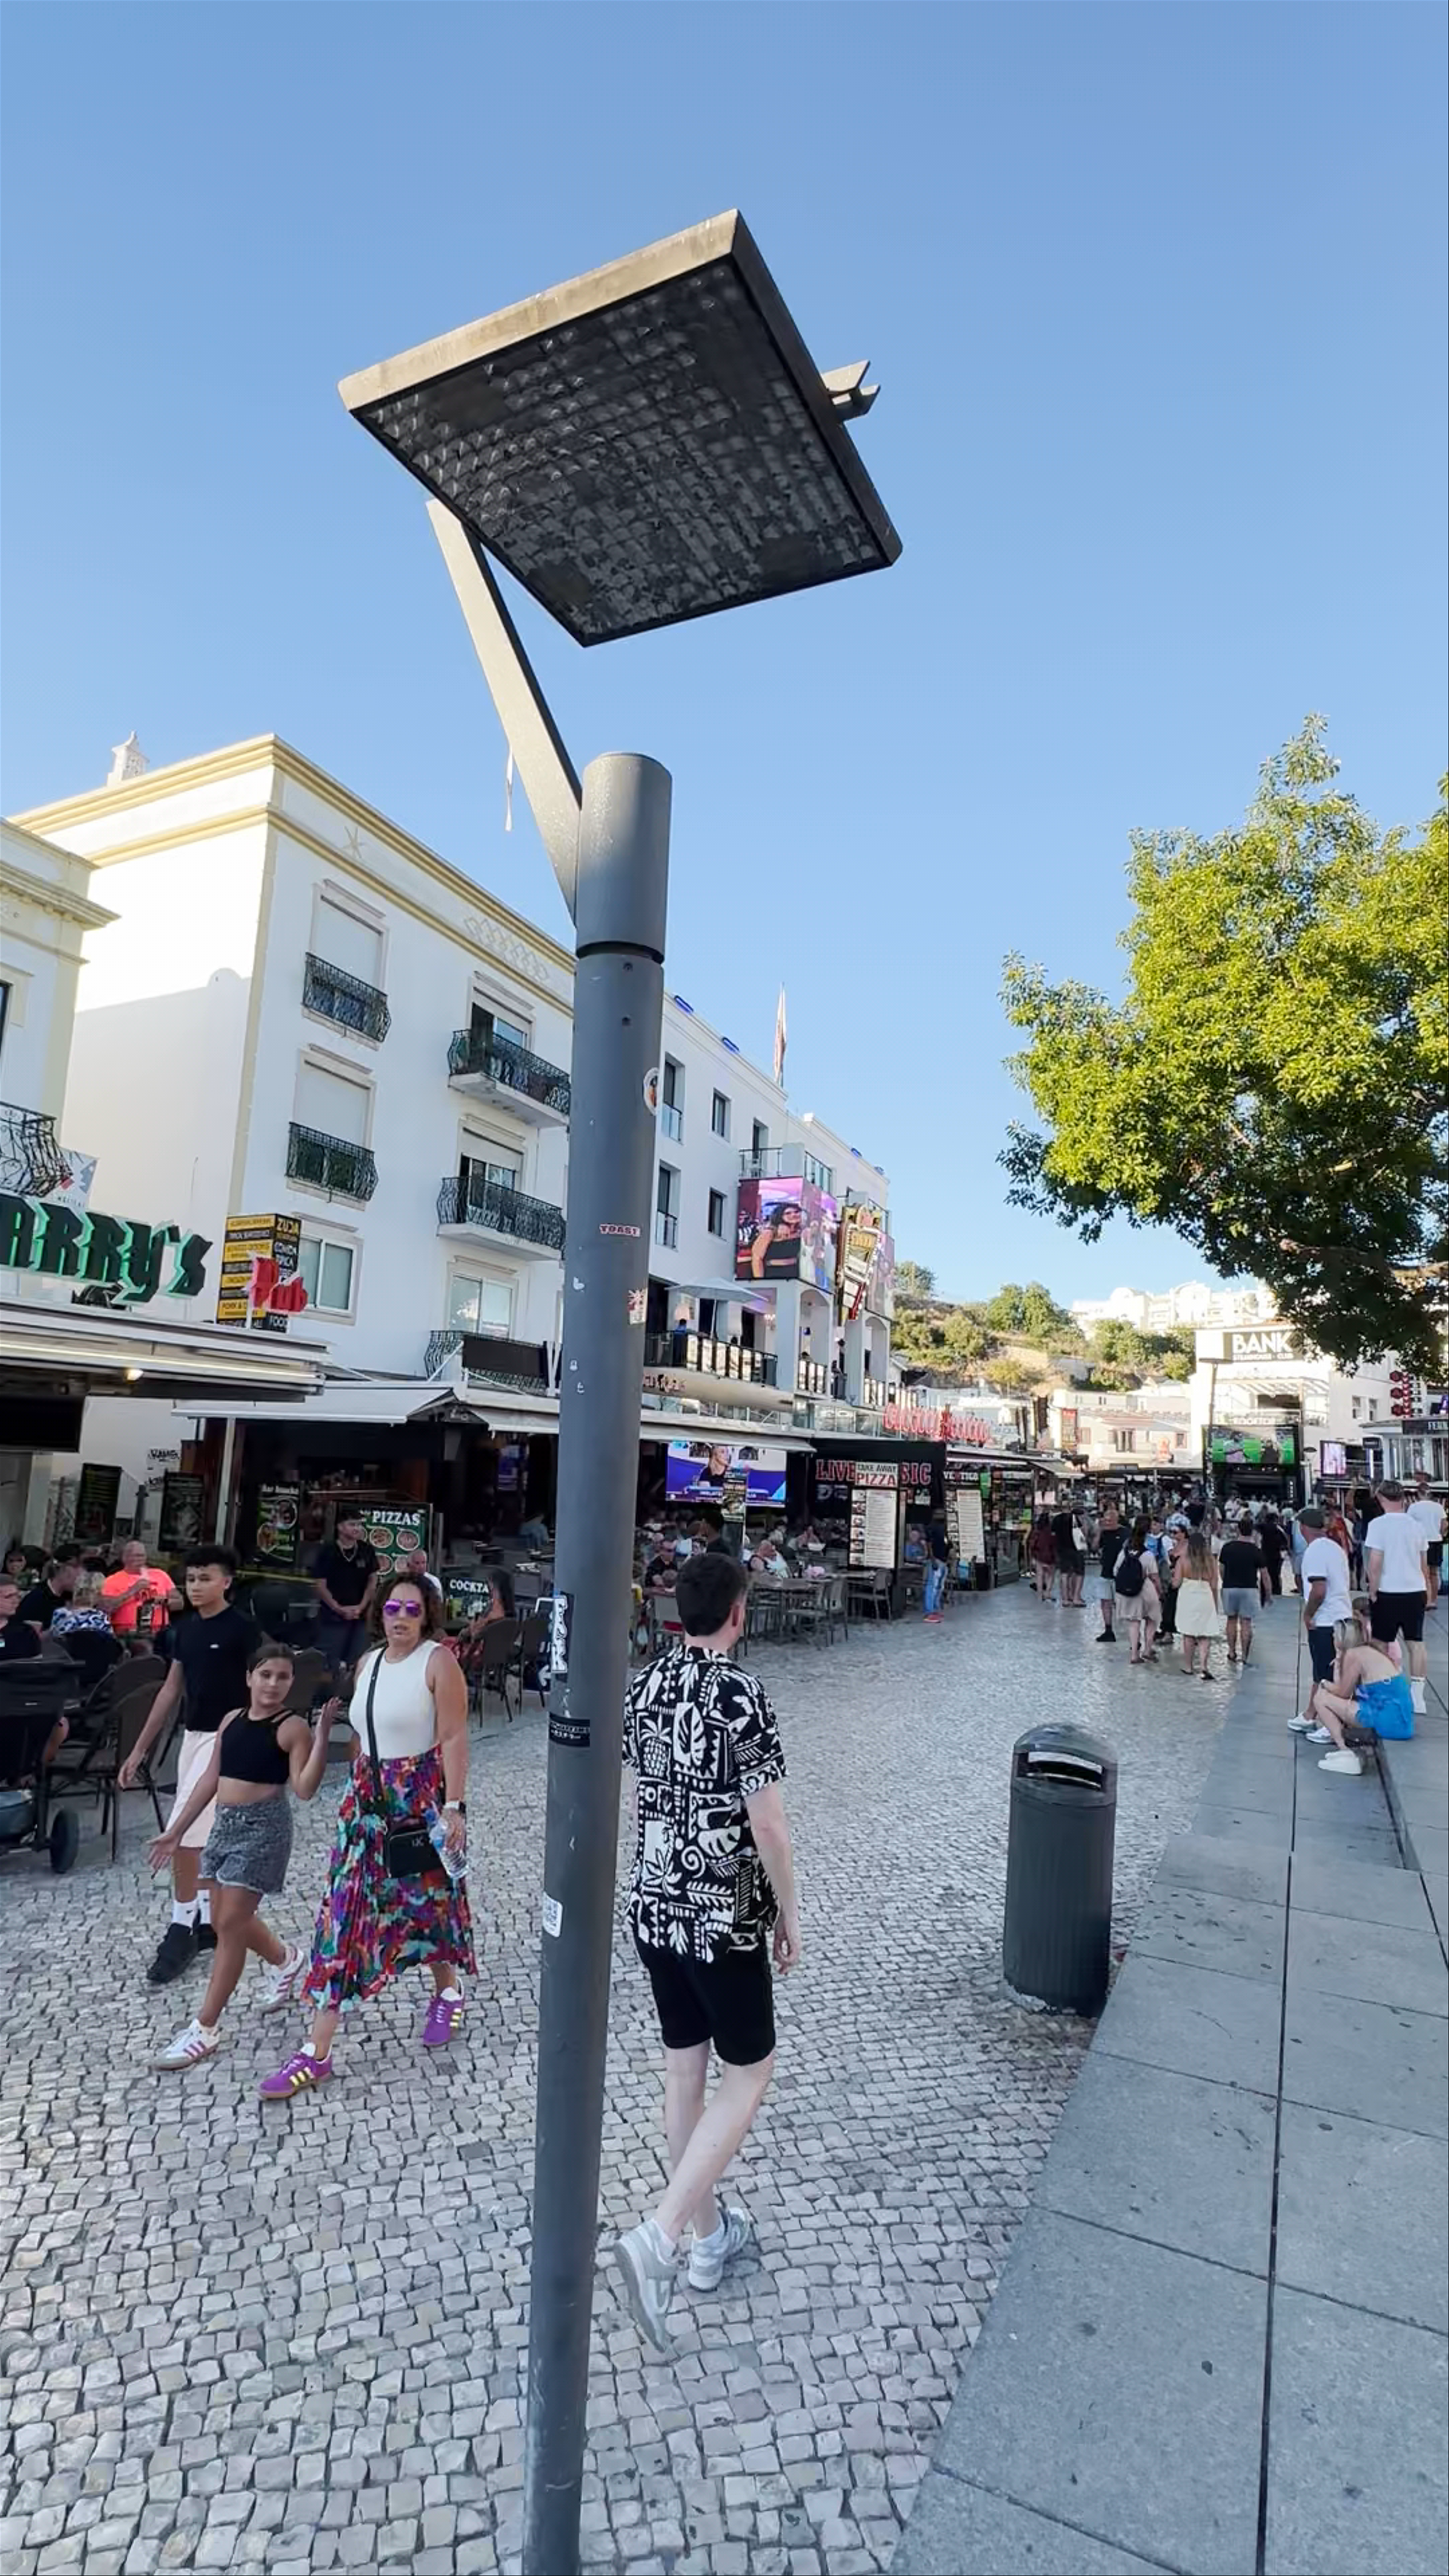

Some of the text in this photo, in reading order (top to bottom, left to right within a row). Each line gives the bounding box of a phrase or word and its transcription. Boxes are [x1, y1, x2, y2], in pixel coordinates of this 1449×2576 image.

[1232, 1332, 1293, 1353] BANK
[815, 1459, 931, 1485] LIVE SIC
[856, 1472, 896, 1485] PIZZA
[372, 1511, 420, 1525] PIZZAS
[450, 1579, 489, 1593] COCKTA
